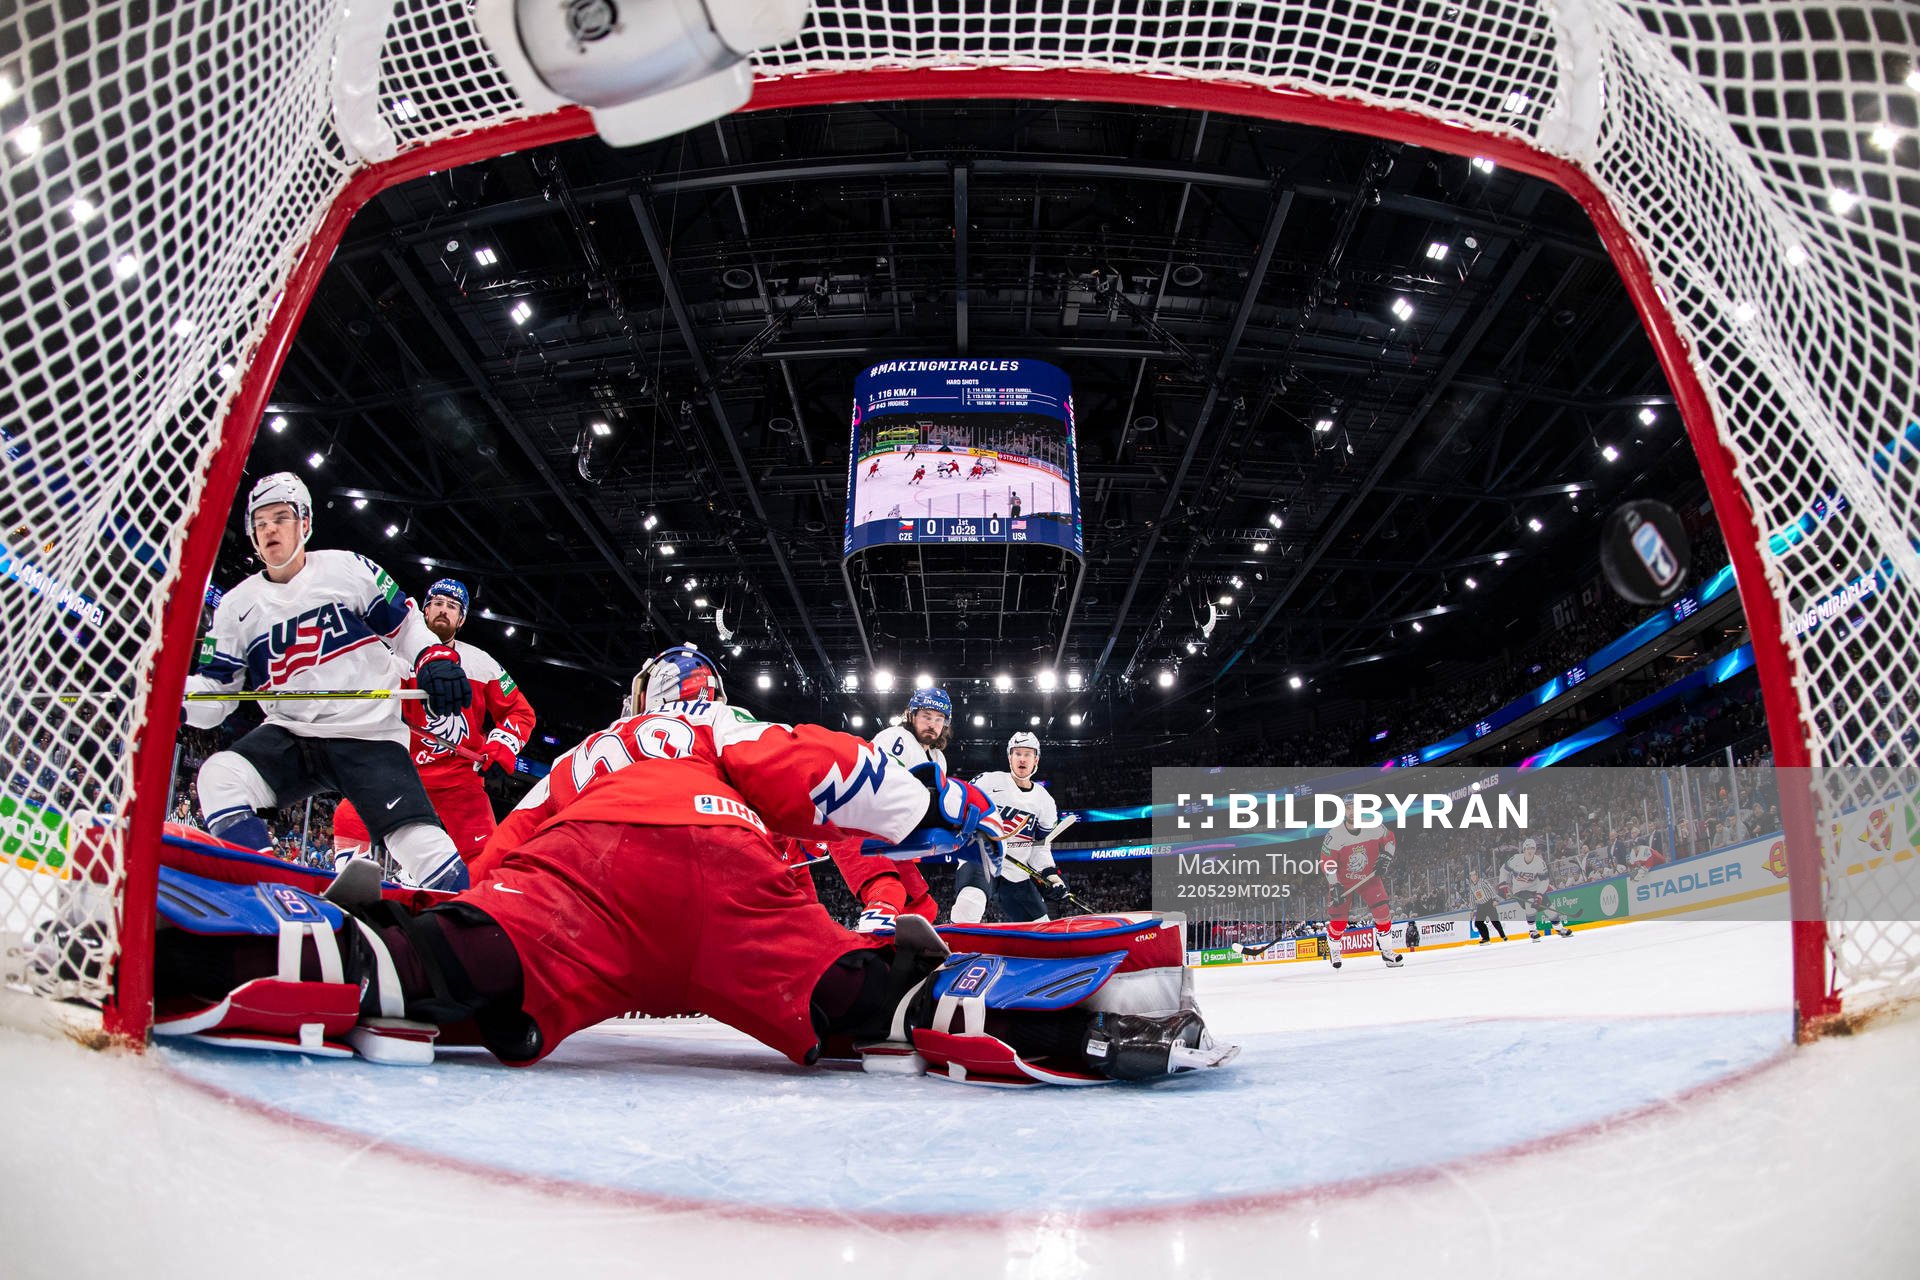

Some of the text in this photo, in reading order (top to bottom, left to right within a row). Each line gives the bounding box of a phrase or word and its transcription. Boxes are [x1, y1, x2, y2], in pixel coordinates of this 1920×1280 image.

[870, 360, 1019, 378] #MAKINGMIRACLES
[893, 388, 917, 397] KM/H
[926, 519, 936, 534] 0
[950, 526, 977, 535] 10:28
[989, 519, 1000, 534] 0
[898, 532, 913, 541] CZE
[1012, 532, 1027, 541] USA
[271, 602, 347, 686] USA
[923, 698, 944, 708] ENYAQ
[891, 736, 904, 756] 6
[1091, 845, 1172, 860] MAKING MIRACLES
[1636, 862, 1742, 902] STADLER
[1562, 896, 1579, 908] Paper
[1431, 922, 1455, 934] TISSOT
[958, 966, 987, 990] 50
